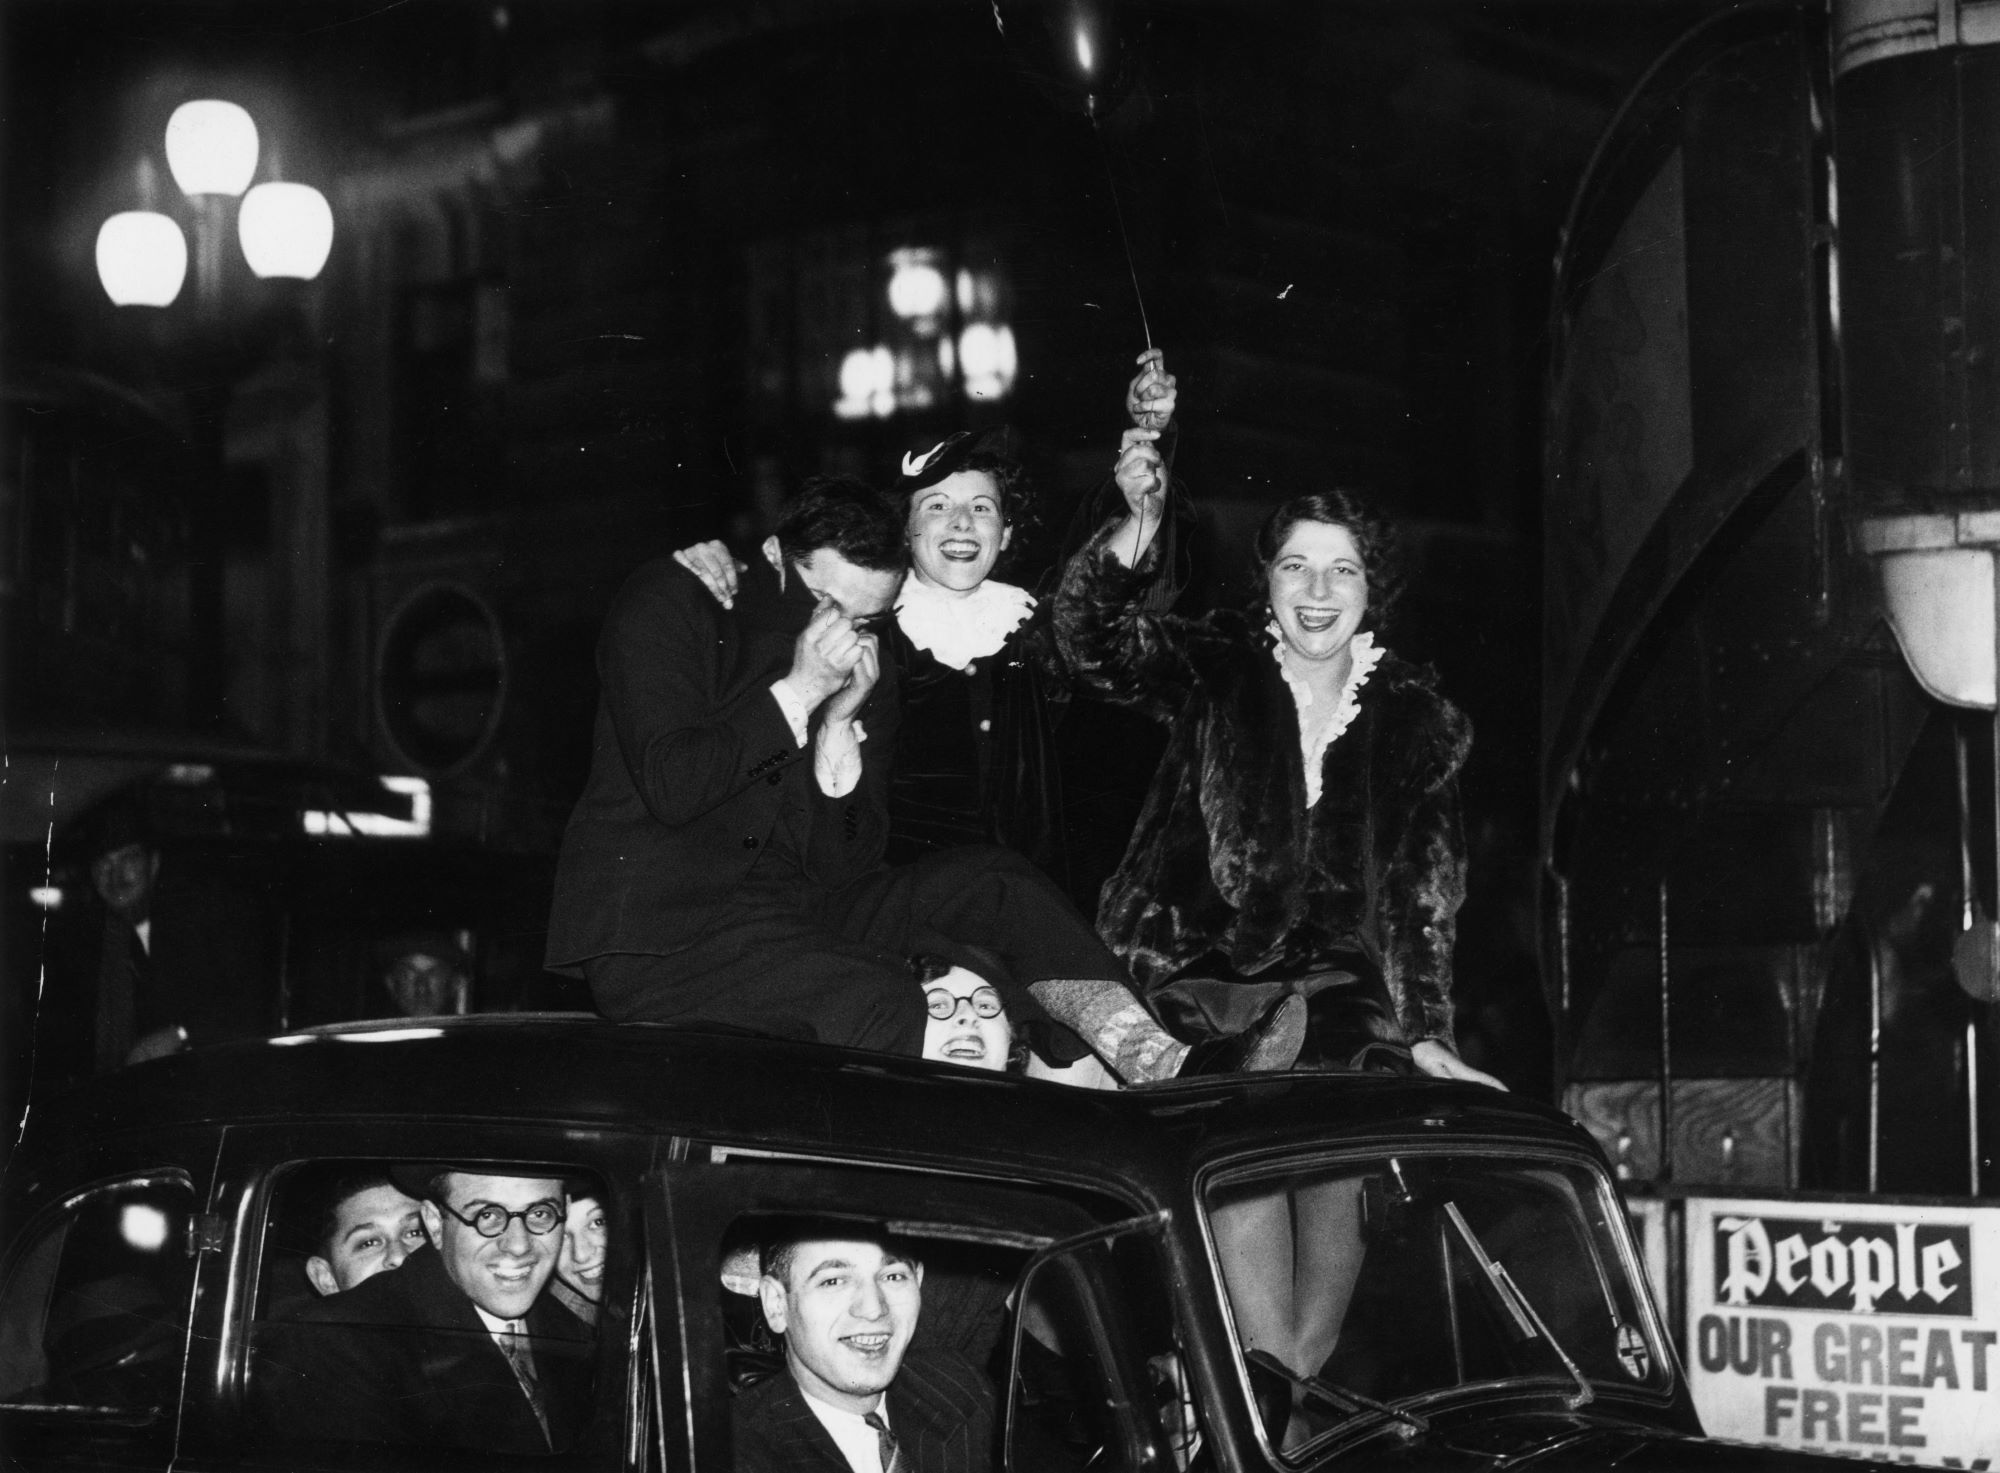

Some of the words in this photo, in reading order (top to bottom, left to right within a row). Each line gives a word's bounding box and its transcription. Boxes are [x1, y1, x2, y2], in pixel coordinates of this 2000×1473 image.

[1718, 1217, 1962, 1312] People
[1698, 1314, 1793, 1379] OUR
[1814, 1322, 1997, 1391] GREAT
[1765, 1386, 1926, 1448] FREE
